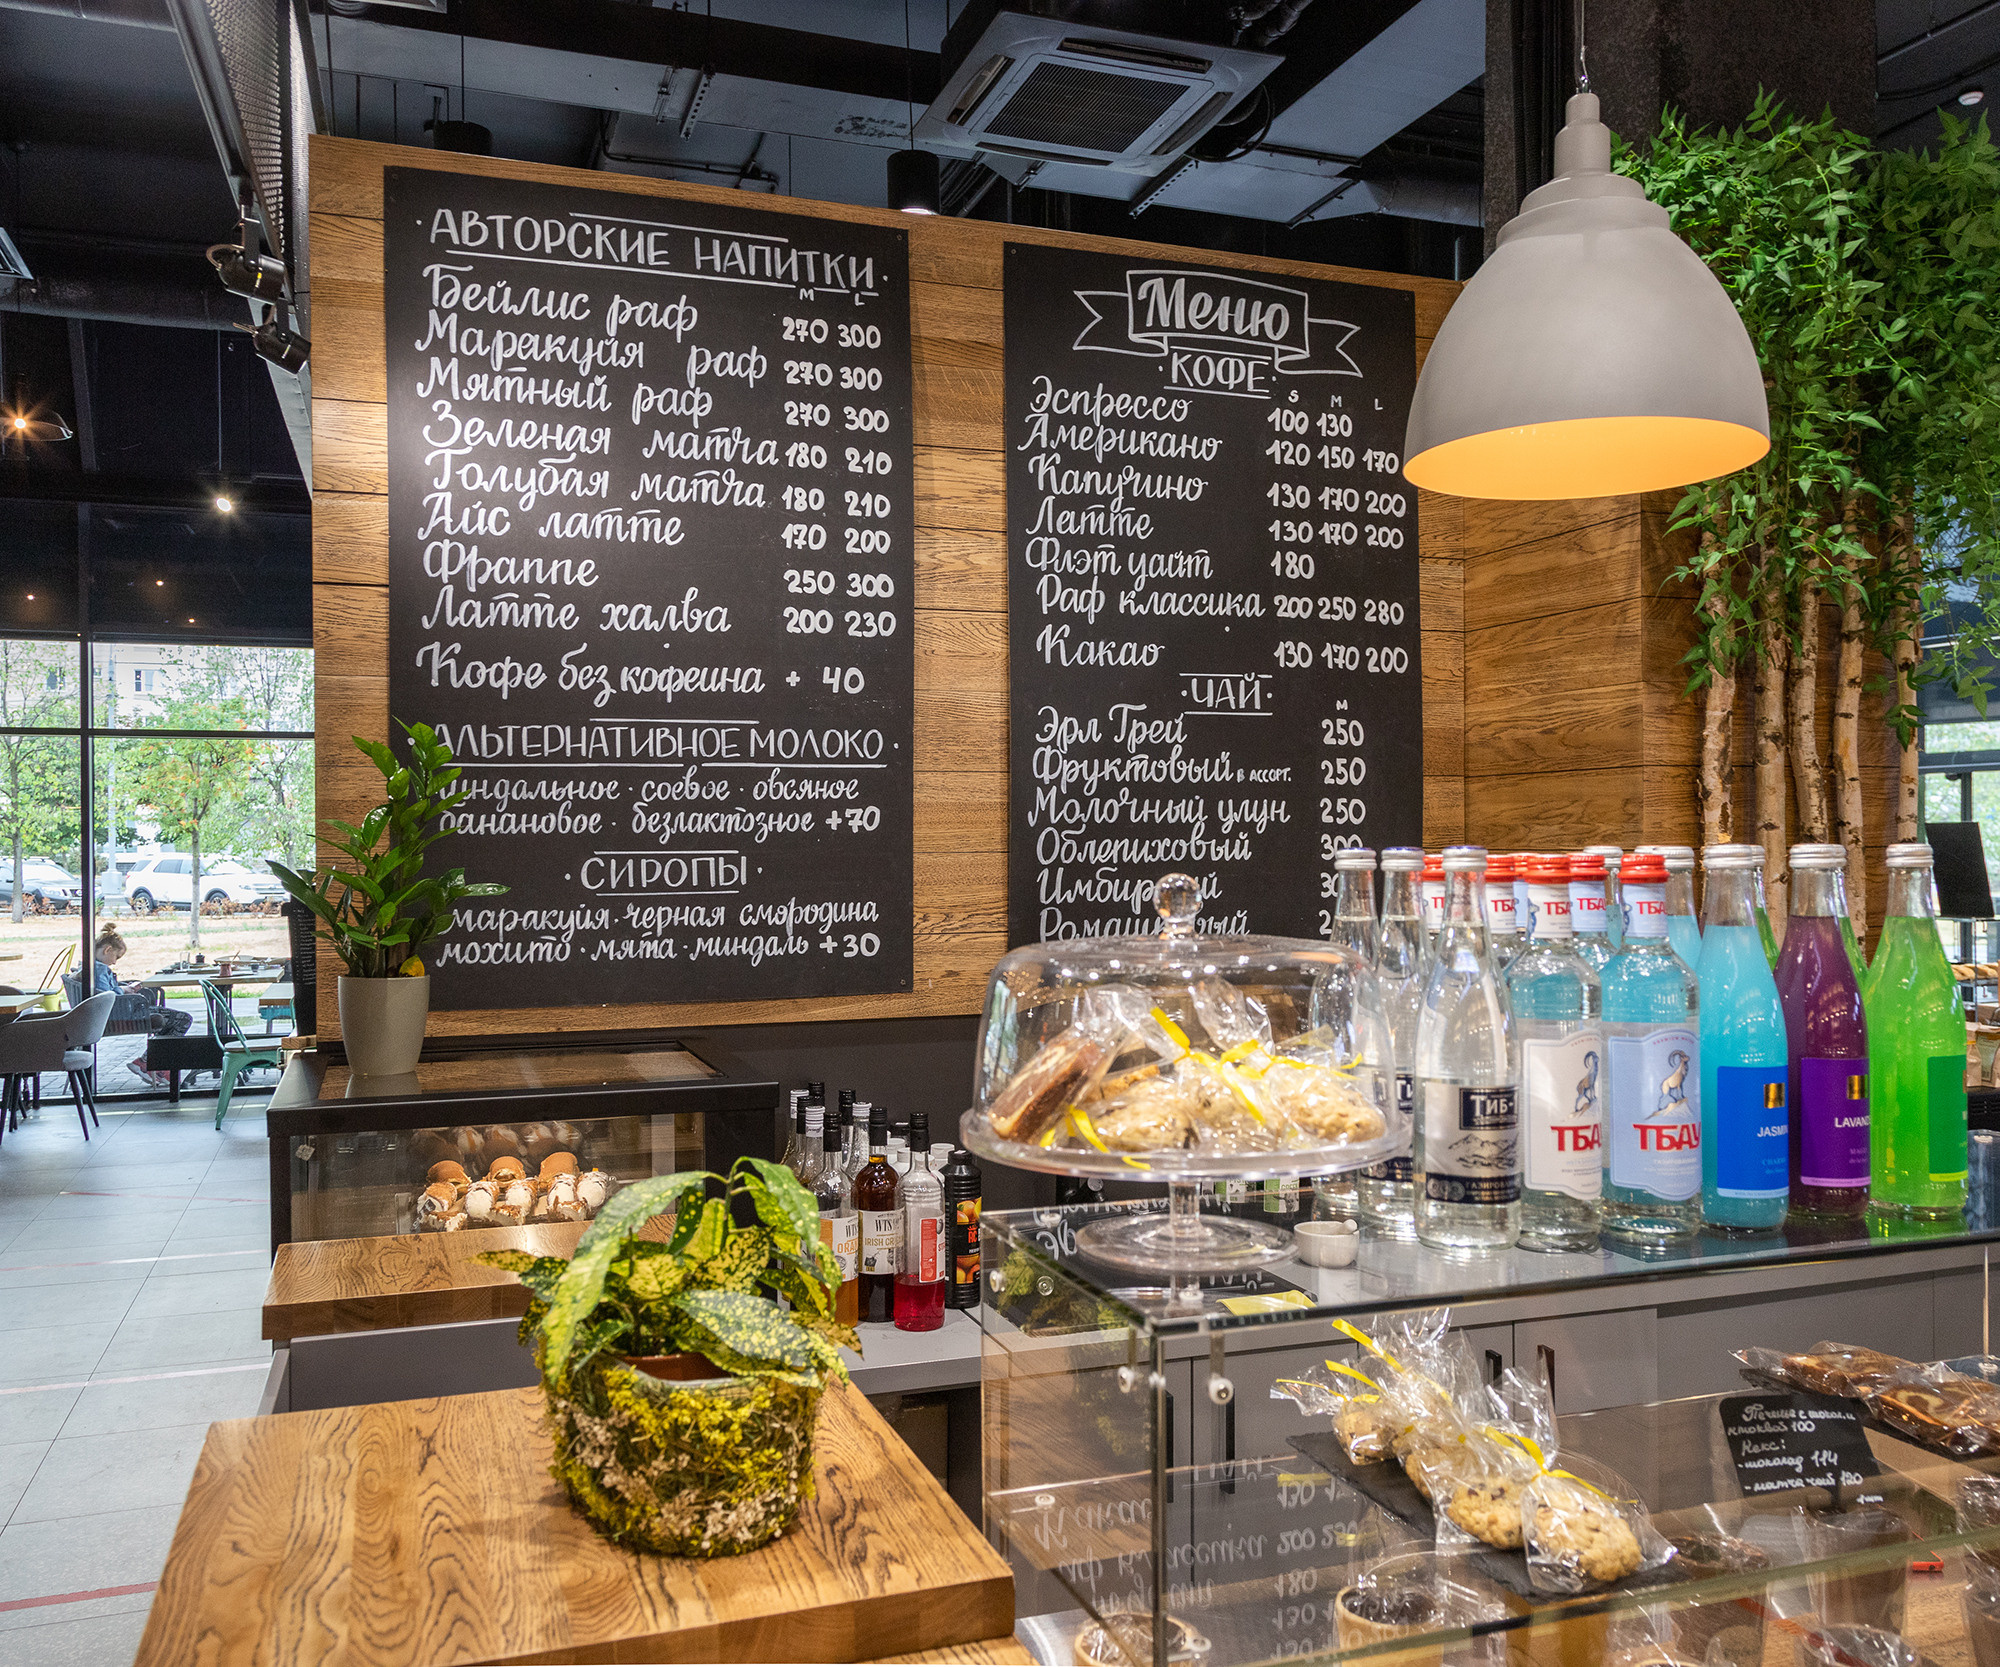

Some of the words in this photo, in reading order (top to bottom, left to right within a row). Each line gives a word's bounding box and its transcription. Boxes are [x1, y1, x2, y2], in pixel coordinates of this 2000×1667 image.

[430, 208, 671, 266] АВТОРСКИЕ
[694, 236, 874, 290] НАПИТКИ
[422, 263, 591, 323] Бейлис
[606, 294, 698, 343] раф
[782, 316, 829, 344] 270
[838, 322, 882, 349] 300
[1137, 277, 1290, 341] Меню
[414, 309, 645, 376] Маракуйя
[687, 345, 768, 391] раф
[783, 360, 833, 387] 270
[839, 365, 883, 392] 300
[1171, 352, 1270, 392] КОФЕ
[416, 356, 612, 412] Мятный
[631, 382, 713, 428] раф
[784, 401, 832, 428] 270
[844, 406, 891, 433] 300
[1029, 375, 1193, 426] Эспрессо
[1267, 408, 1308, 435] 100
[1316, 412, 1352, 438] 130
[422, 400, 611, 455] Зеленая
[642, 427, 780, 467] матча
[785, 441, 827, 470] 180
[846, 447, 893, 475] 210
[1017, 413, 1222, 463] Американо
[1266, 440, 1311, 467] 120
[1317, 444, 1355, 470] 150
[1362, 449, 1399, 475] 170
[424, 447, 609, 510] Голубая
[631, 469, 766, 508] матча
[781, 484, 825, 512] 180
[844, 489, 891, 518] 210
[1027, 453, 1208, 512] Капучино
[1266, 483, 1311, 509] 130
[1318, 486, 1360, 513] 170
[1365, 490, 1407, 518] 200
[417, 491, 511, 540] Айс
[539, 507, 685, 545] латте
[781, 522, 827, 550] 170
[844, 527, 891, 555] 200
[1026, 496, 1154, 539] Латте
[1268, 519, 1313, 544] 130
[1318, 522, 1358, 546] 170
[1365, 525, 1404, 550] 200
[423, 539, 599, 592] Фраппе
[783, 569, 836, 595] 250
[845, 572, 895, 598] 300
[1025, 536, 1122, 576] Флэт
[1128, 549, 1213, 592] уайт
[1270, 550, 1315, 580] 180
[421, 584, 579, 631] Латте
[600, 588, 732, 633] халва
[783, 607, 834, 634] 200
[844, 610, 897, 637] 230
[1036, 574, 1106, 624] Раф
[1119, 589, 1266, 618] классика
[1274, 595, 1314, 619] 200
[1317, 597, 1357, 621] 250
[1364, 599, 1404, 626] 280
[416, 642, 548, 700] Кофе
[556, 642, 617, 708] без
[620, 656, 766, 702] кофеина
[823, 667, 865, 693] 40
[1036, 624, 1165, 668] Какао
[1273, 641, 1313, 668] 130
[1320, 642, 1360, 671] 170
[1365, 647, 1409, 674] 200
[1191, 672, 1261, 710] ЧАЙ
[434, 724, 741, 759] АЛЬТЕРНАТИВНОЕ
[750, 728, 884, 759] МОЛОКО
[1035, 705, 1102, 753] Эрл
[1108, 702, 1188, 754] Грей
[1321, 719, 1364, 747] 250
[438, 778, 620, 812] индальное
[641, 765, 731, 801] соевое
[753, 769, 859, 801] овсяное
[1032, 745, 1235, 795] Фруктовый
[1321, 757, 1366, 786] 250
[439, 800, 603, 835] банановое
[632, 802, 815, 843] безлактозное
[1027, 786, 1208, 827] Молочный
[1217, 799, 1291, 834] улун
[1320, 798, 1367, 825] 250
[1036, 823, 1252, 866] Облепиховый
[580, 856, 747, 890] СИРОПЫ
[1037, 867, 1223, 915] Имбирй
[438, 907, 610, 943] маракуйя
[622, 903, 725, 935] черная
[739, 897, 879, 937] смородина
[436, 935, 570, 967] мохито
[591, 931, 677, 961] мята
[689, 936, 810, 967] миндаль
[1791, 1421, 1816, 1432] 100
